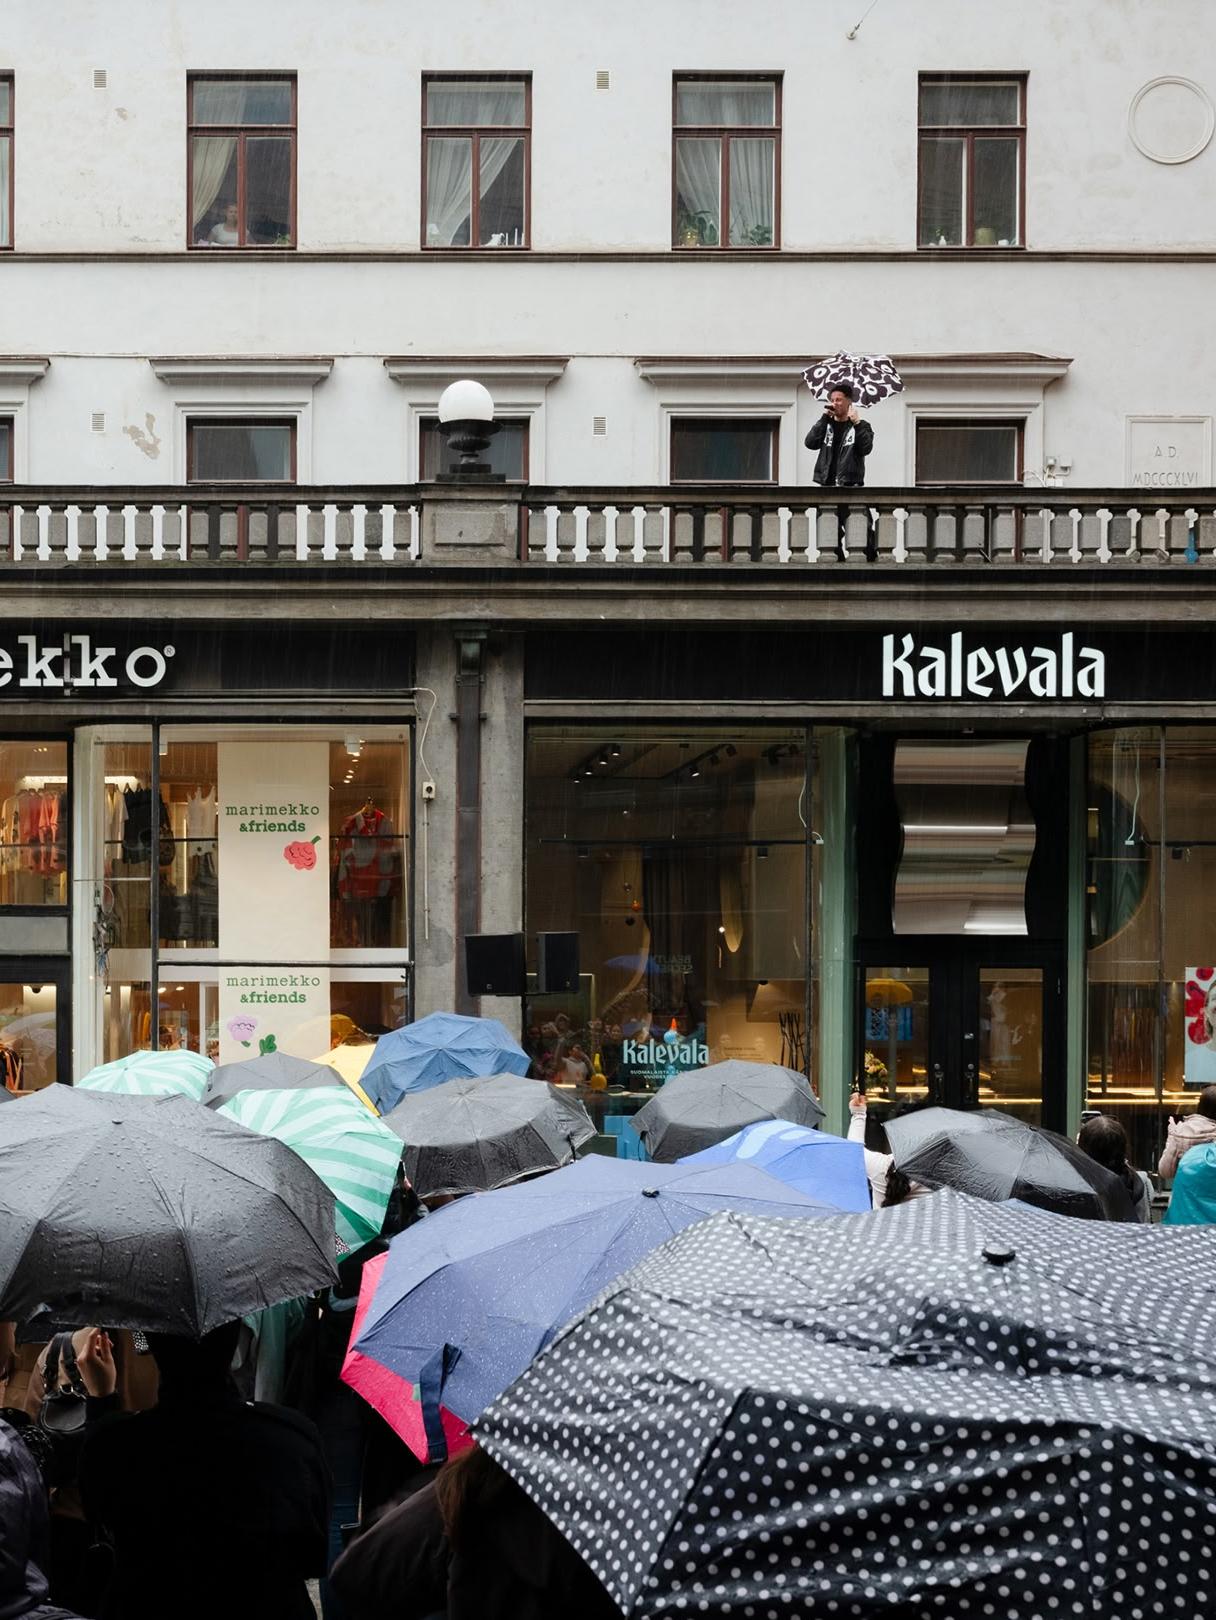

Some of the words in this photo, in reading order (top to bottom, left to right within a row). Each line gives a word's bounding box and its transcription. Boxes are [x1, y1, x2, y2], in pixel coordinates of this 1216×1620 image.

[882, 631, 1105, 698] Kalevala
[225, 803, 320, 815] marimekko
[239, 819, 306, 832] &friends
[226, 974, 321, 987] marimekko
[240, 991, 307, 1003] &friends
[623, 1038, 710, 1064] Kalevala
